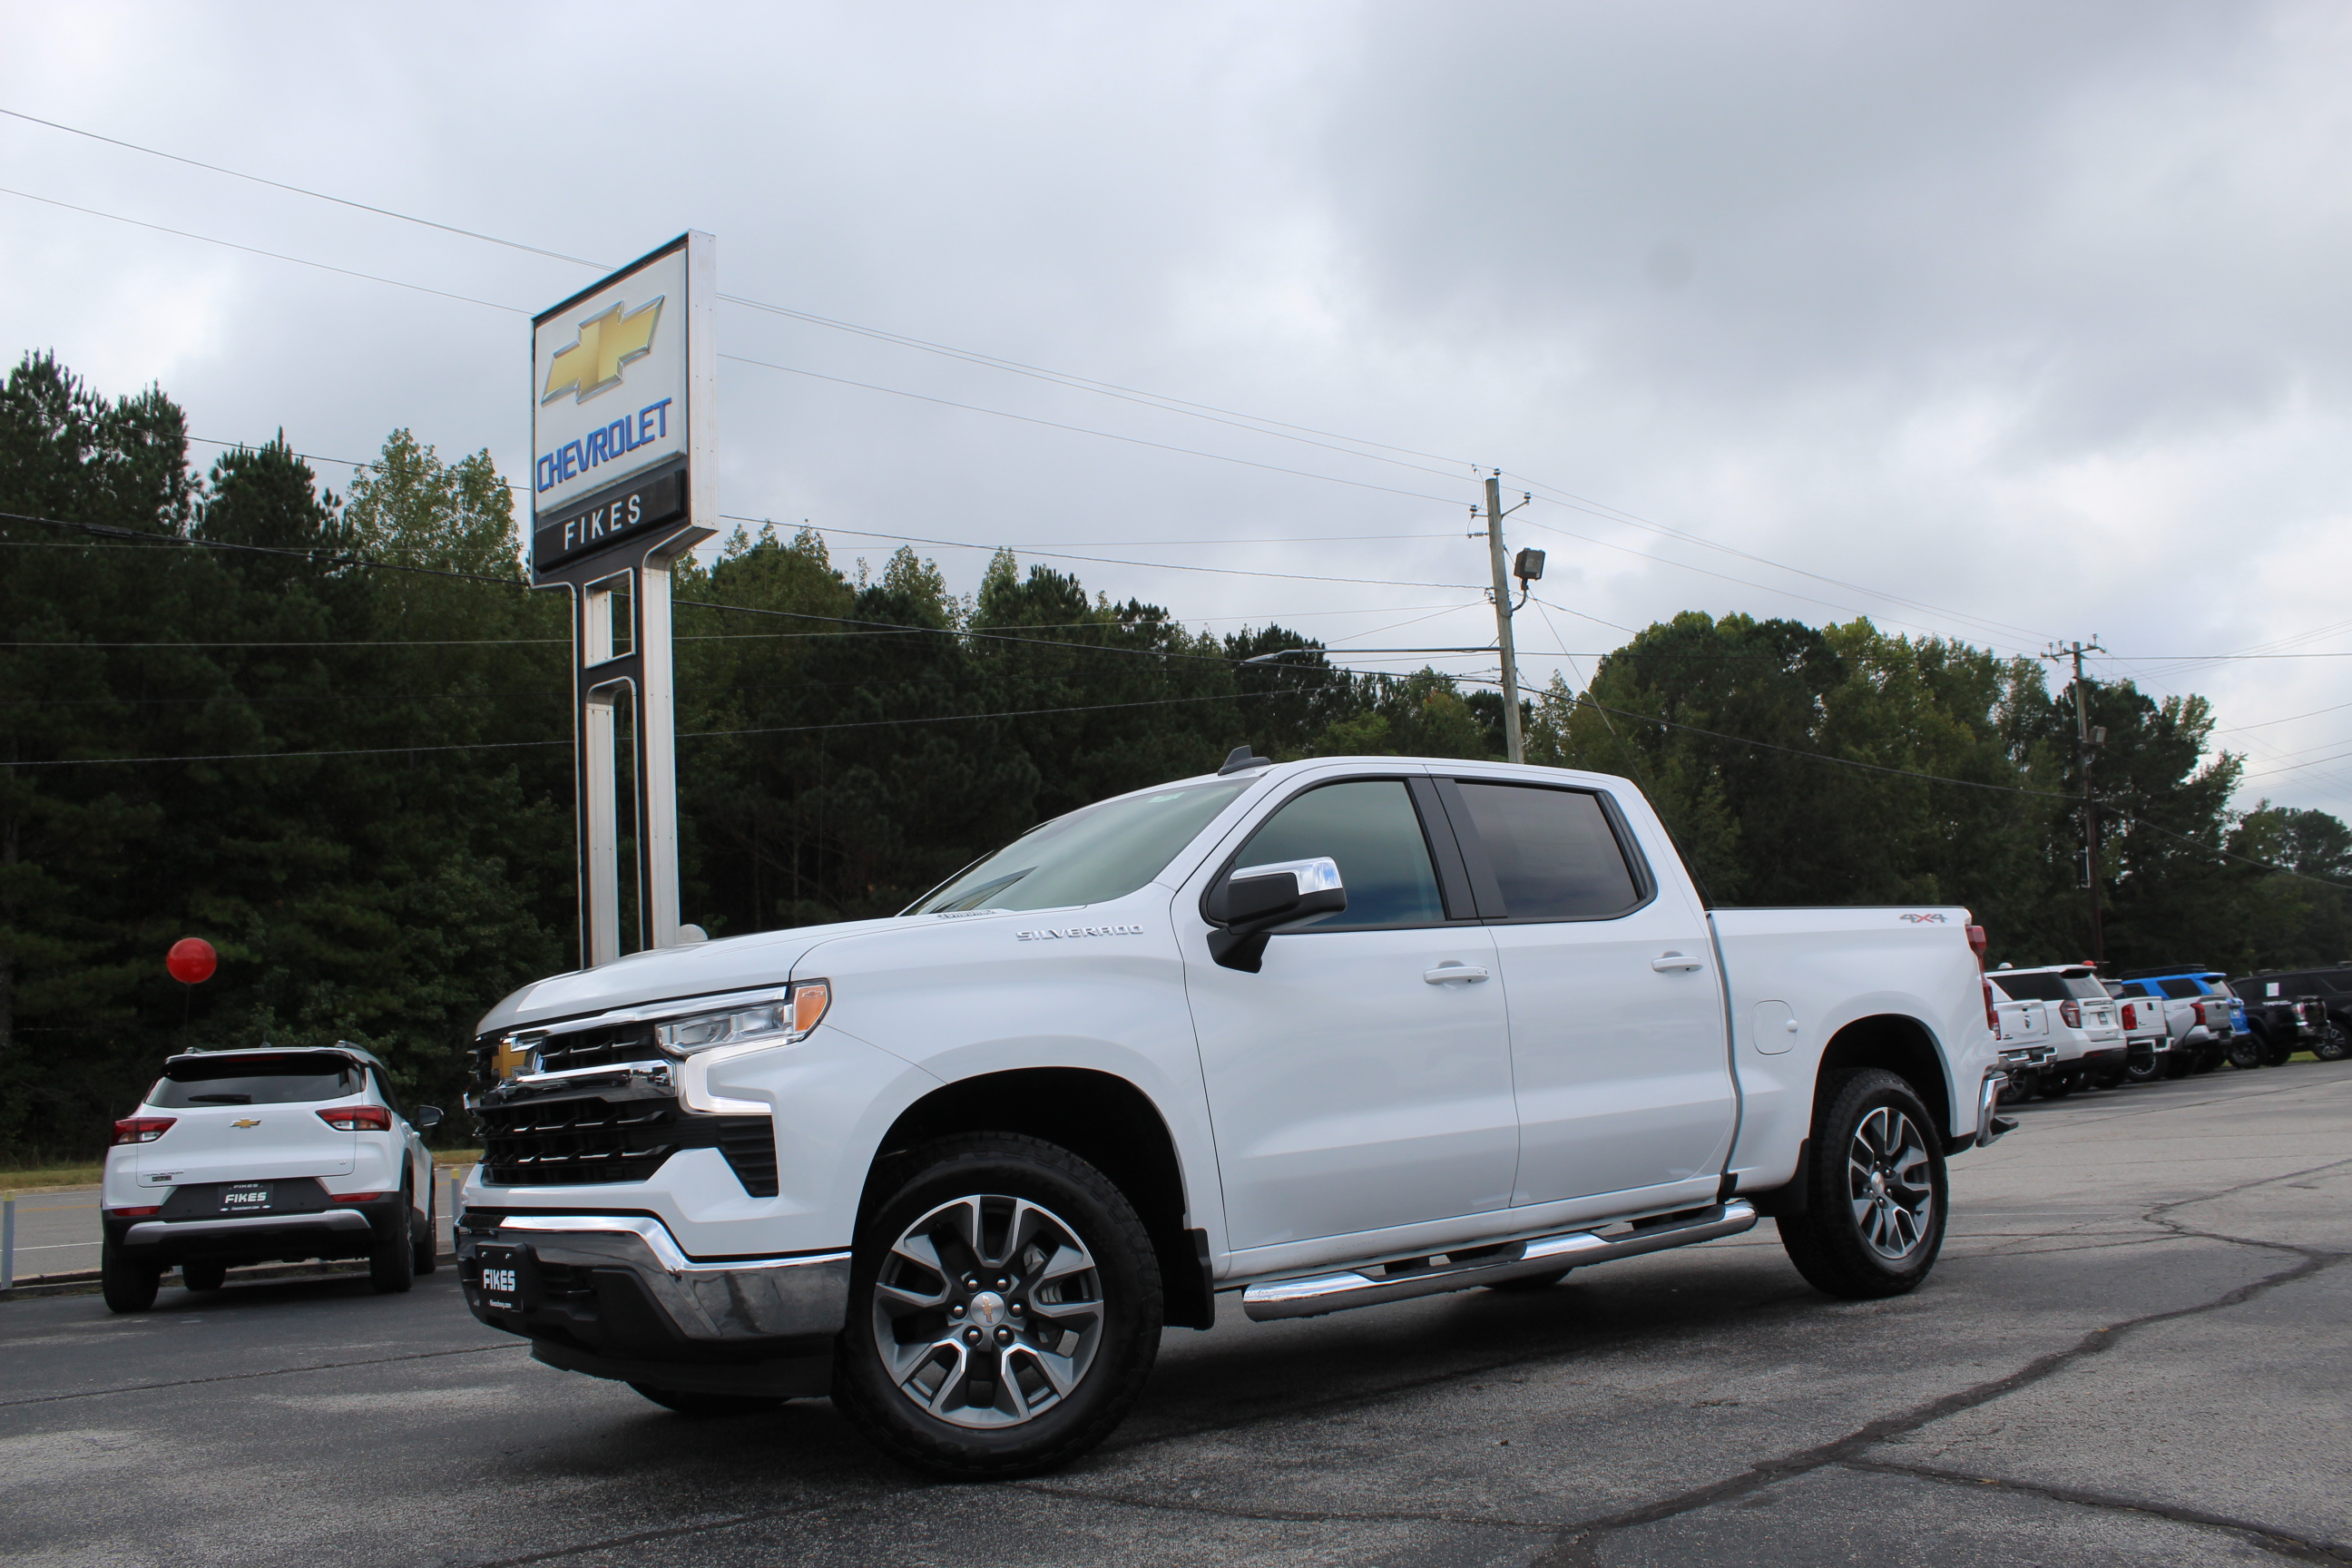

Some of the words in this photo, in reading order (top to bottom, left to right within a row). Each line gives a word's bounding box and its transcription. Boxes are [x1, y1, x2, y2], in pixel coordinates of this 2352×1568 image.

[537, 397, 672, 493] CHEVROLET
[564, 494, 641, 551] FIKES
[1015, 925, 1143, 941] SILVERADO
[224, 1191, 268, 1204] FIKES
[483, 1269, 515, 1292] FIKES
